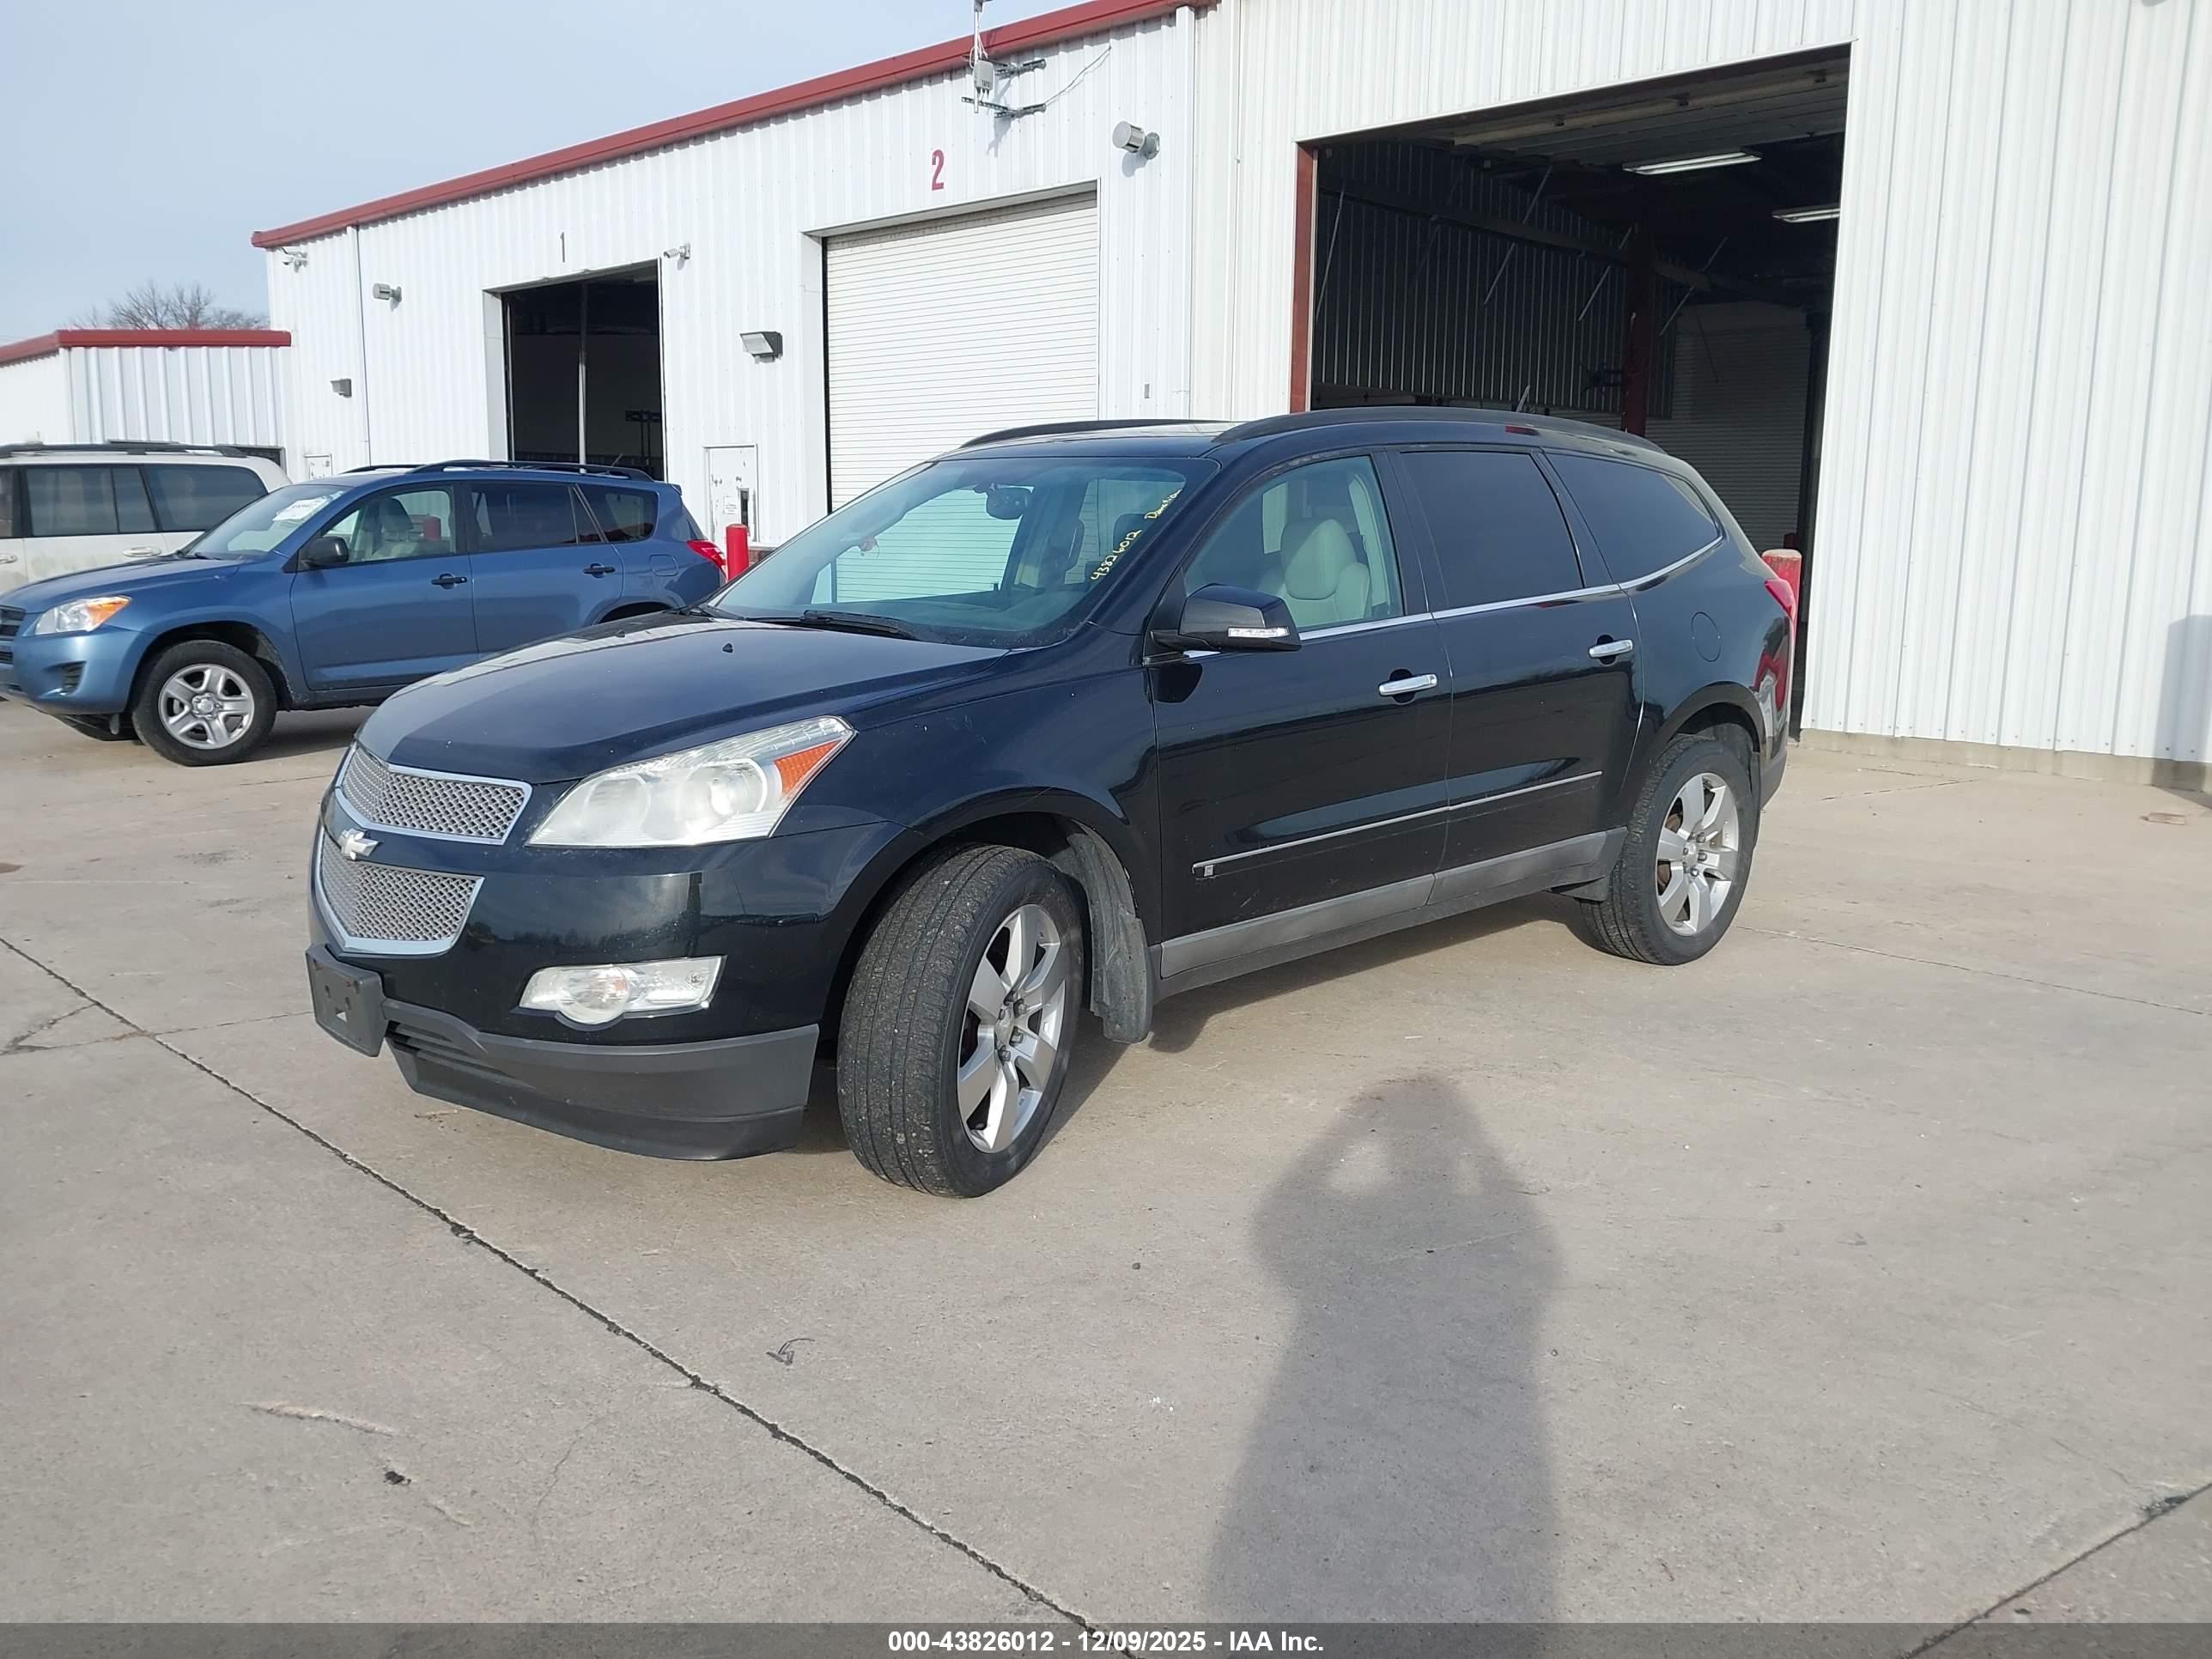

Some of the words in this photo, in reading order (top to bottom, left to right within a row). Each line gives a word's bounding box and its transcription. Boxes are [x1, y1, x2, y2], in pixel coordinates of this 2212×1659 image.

[931, 149, 945, 191] 2
[560, 231, 566, 263] 1
[1091, 529, 1143, 580] 43826012
